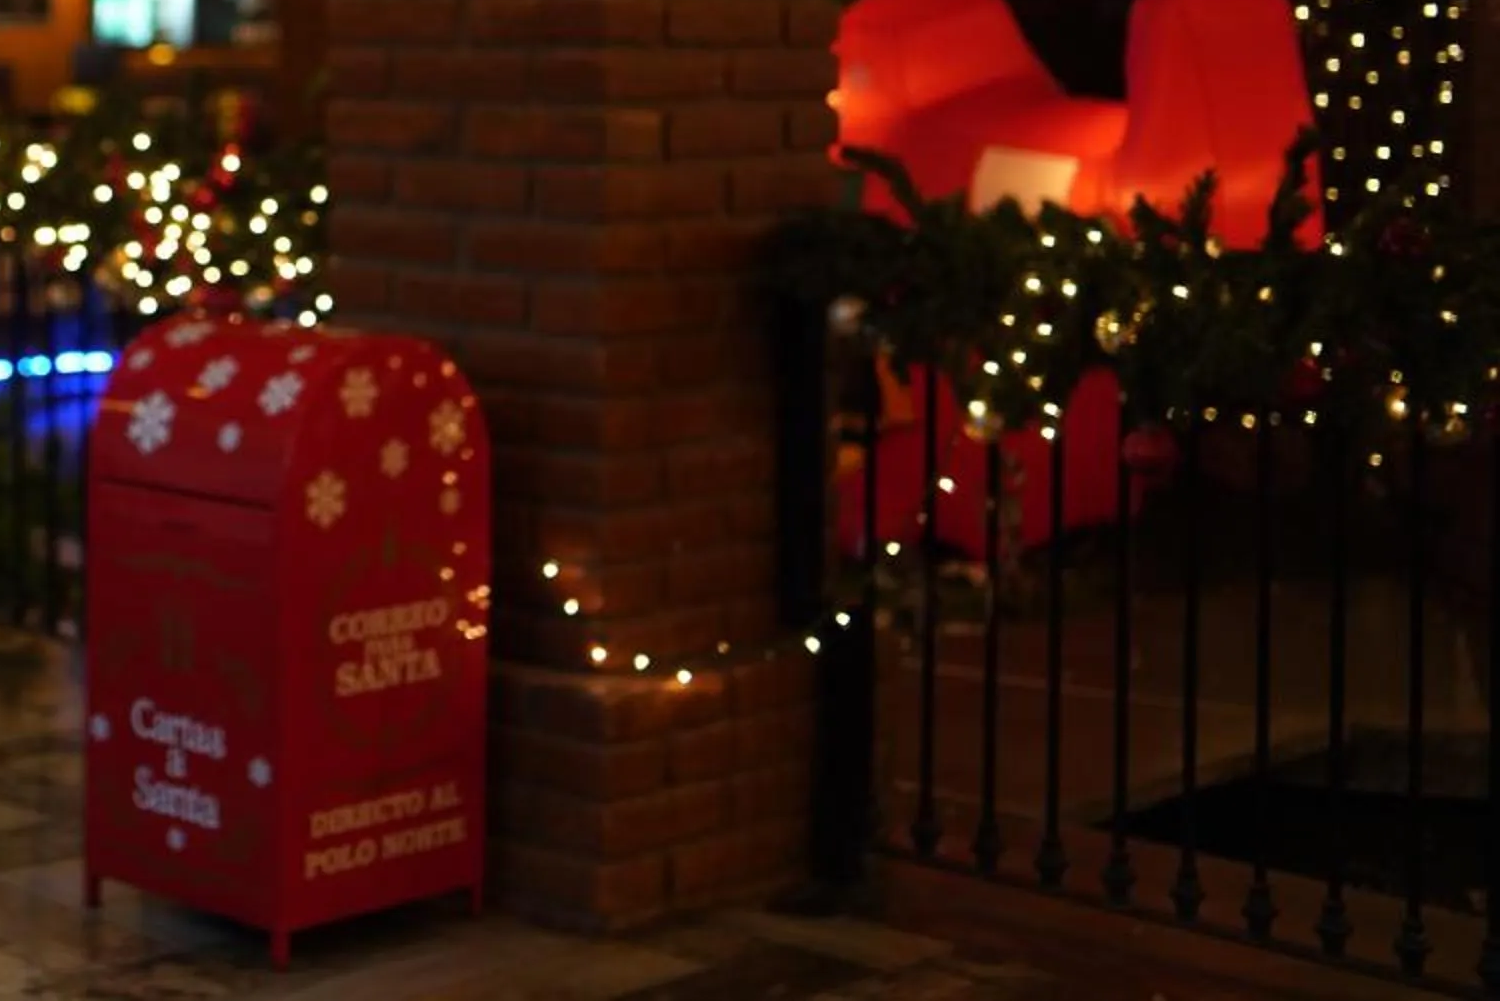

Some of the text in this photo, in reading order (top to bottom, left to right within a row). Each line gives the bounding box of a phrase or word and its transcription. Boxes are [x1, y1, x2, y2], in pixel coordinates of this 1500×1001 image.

[335, 648, 442, 696] SANTA
[132, 765, 219, 829] Santa
[304, 837, 378, 880] POLO
